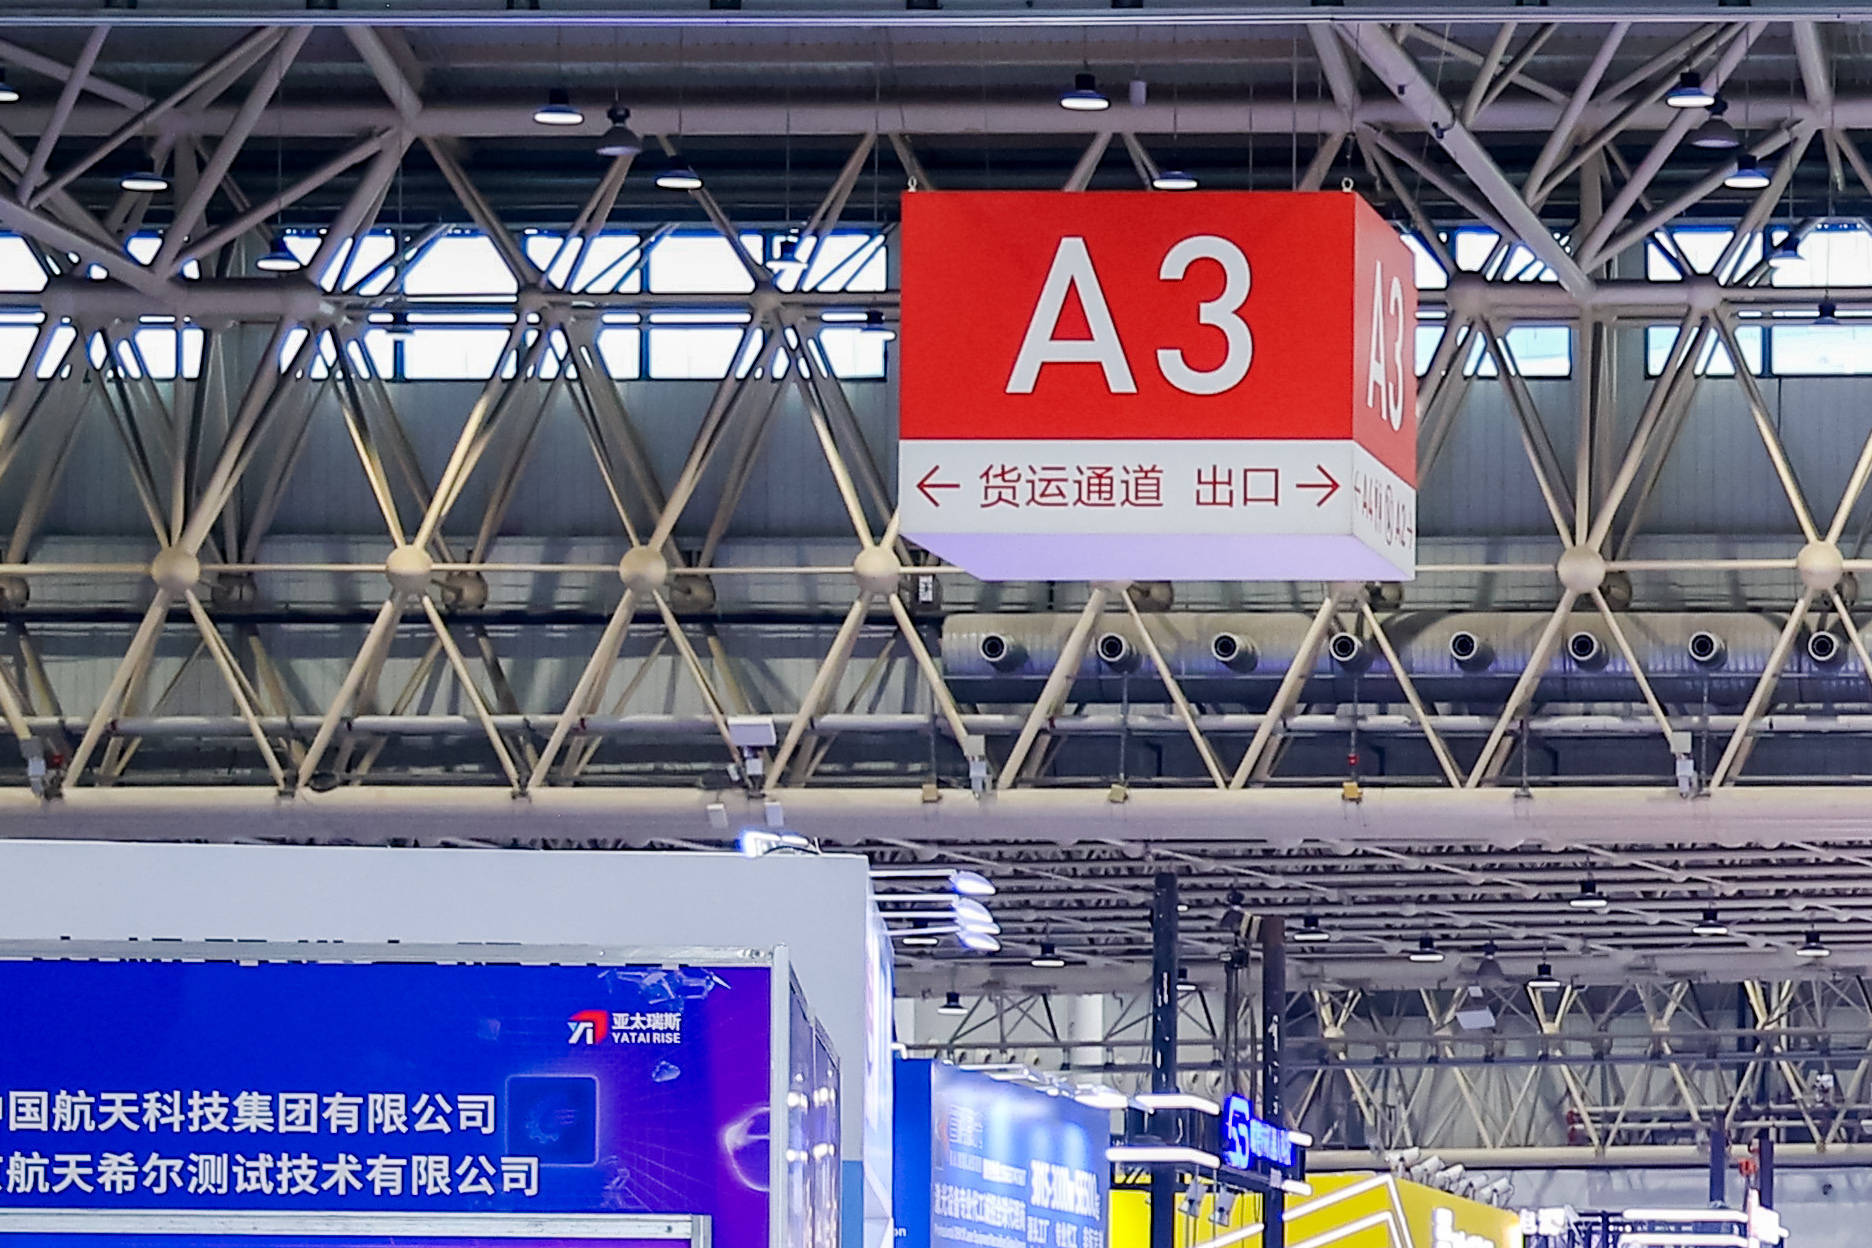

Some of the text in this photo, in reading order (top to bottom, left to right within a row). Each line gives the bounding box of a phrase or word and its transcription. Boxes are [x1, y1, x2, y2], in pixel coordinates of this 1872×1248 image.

[1004, 234, 1254, 396] A3
[1367, 259, 1405, 432] A3
[979, 464, 1280, 509] 货运通道 出口
[611, 1012, 682, 1031] 亚太瑞斯
[611, 1032, 681, 1044] YATAI RISE
[0, 1090, 498, 1135] 国航天科技集团有限公司
[0, 1151, 540, 1197] 航天希尔测试技术有限公司
